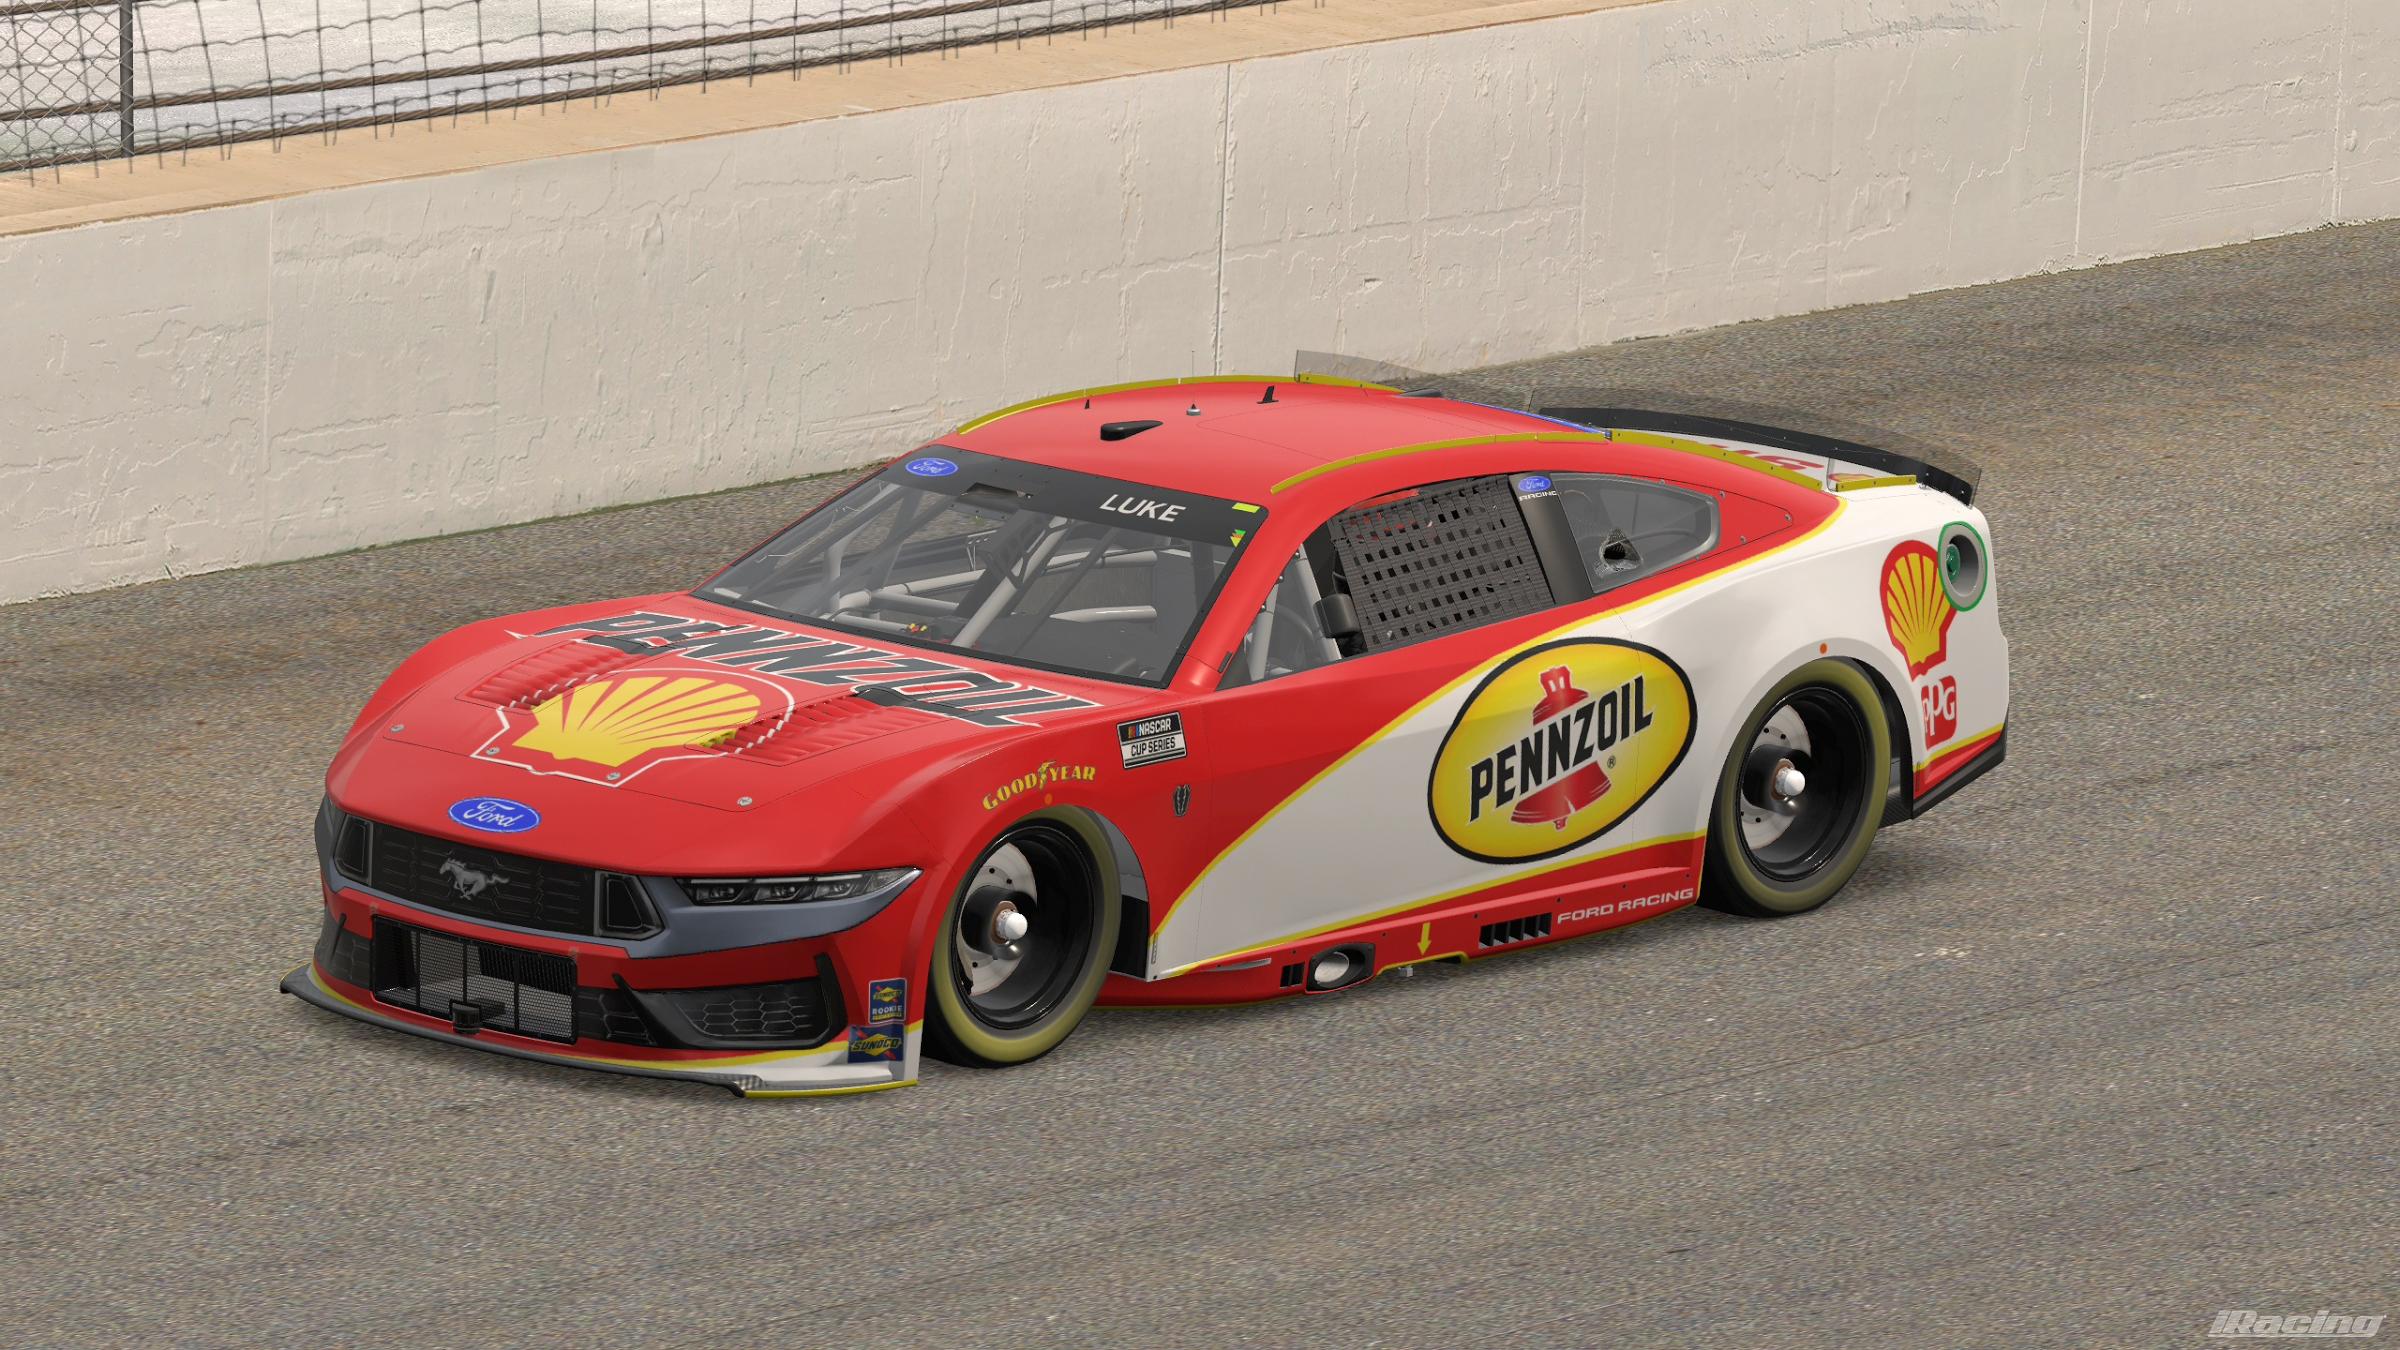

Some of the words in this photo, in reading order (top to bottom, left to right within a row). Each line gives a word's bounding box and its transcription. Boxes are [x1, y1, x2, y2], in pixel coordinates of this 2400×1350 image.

[1099, 494, 1186, 522] LUKE
[503, 610, 1104, 727] PENNZOIL
[1138, 718, 1171, 737] NASCAR
[1131, 743, 1147, 757] CUP
[1148, 736, 1176, 753] SERIES
[1469, 675, 1653, 823] PENNZOIL
[464, 801, 524, 827] Ford
[1557, 903, 1614, 925] FORD
[1617, 887, 1694, 913] RACING
[872, 1005, 903, 1015] ROOKIE
[850, 1038, 902, 1052] SUNOCO
